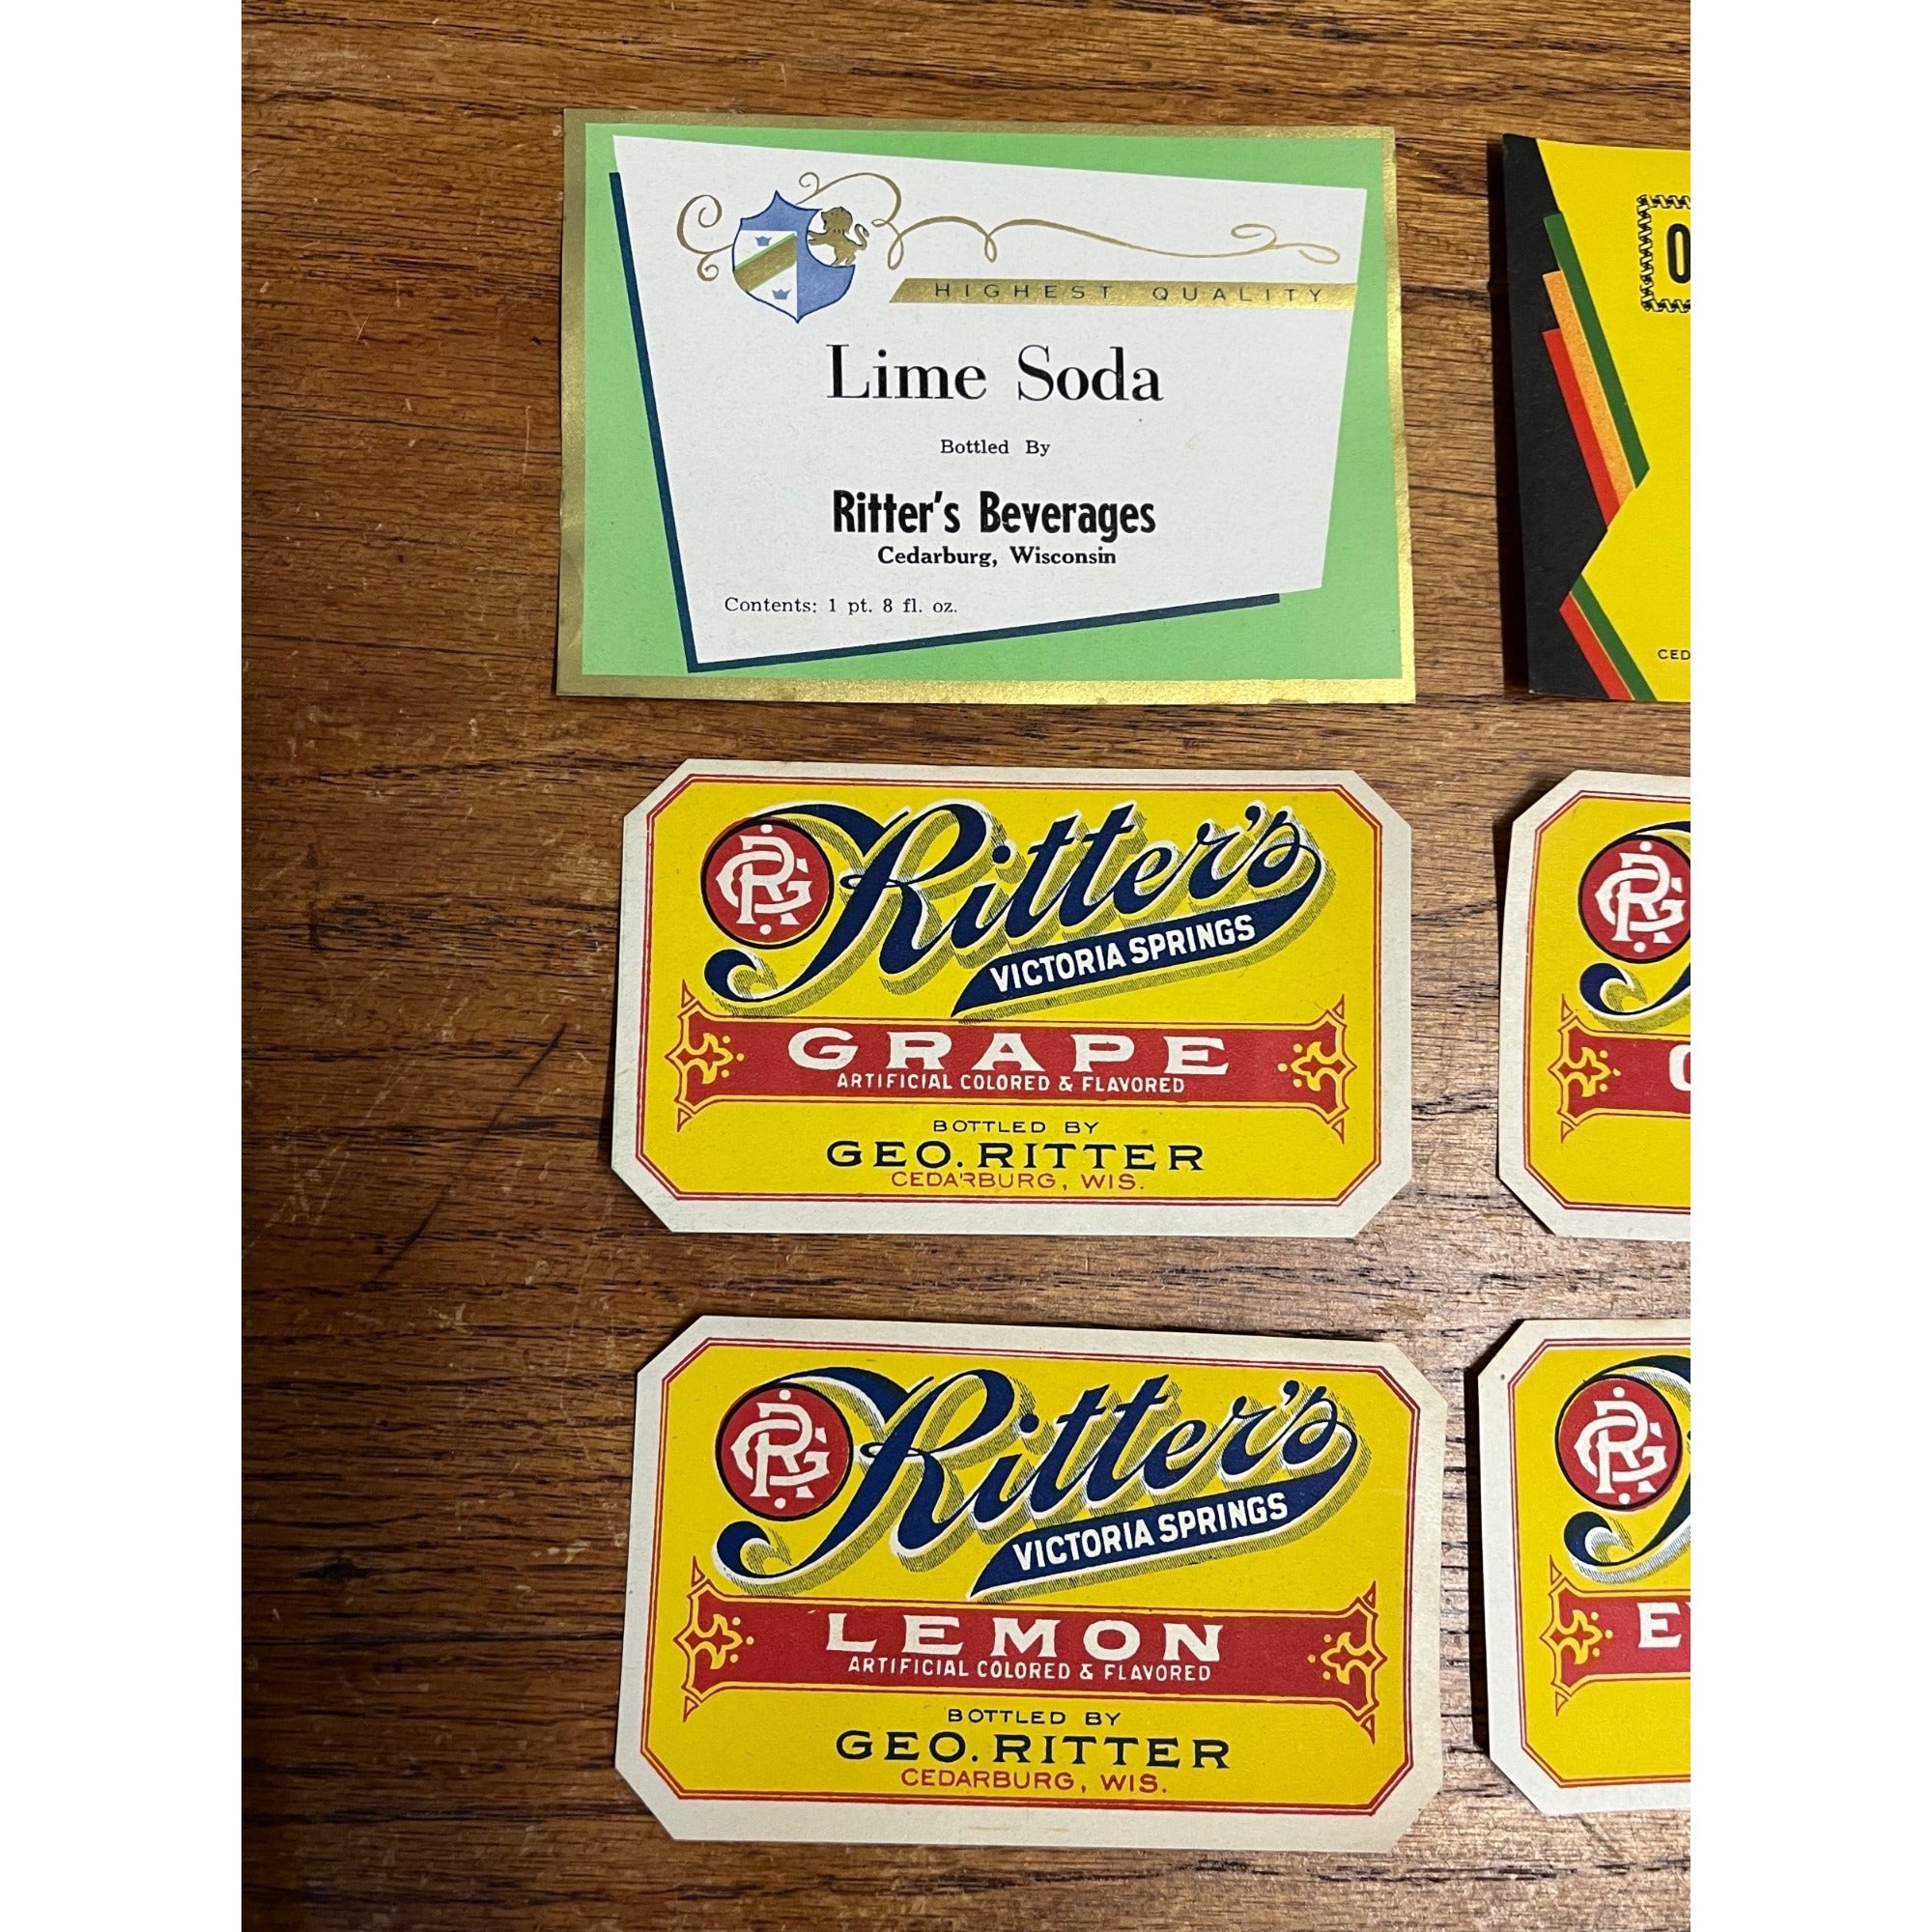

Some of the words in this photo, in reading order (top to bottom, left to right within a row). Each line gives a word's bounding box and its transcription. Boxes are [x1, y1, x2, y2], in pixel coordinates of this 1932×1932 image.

[935, 282, 1113, 300] HIGHEST
[1152, 284, 1324, 303] QUALITY
[826, 344, 987, 401] Lime
[1017, 345, 1164, 402] Soda
[940, 440, 1009, 455] Bottled
[1026, 440, 1051, 459] By
[833, 491, 961, 533] Ritter's
[980, 492, 1156, 543] Beverages
[878, 547, 998, 568] Cedarburg,
[1010, 547, 1117, 565] Wisconsin
[724, 597, 817, 613] Contents:
[829, 597, 837, 612] 1
[848, 599, 872, 617] pt.
[883, 597, 893, 613] 8
[903, 597, 923, 613] fl.
[932, 602, 957, 614] oz.
[705, 804, 1322, 1004] Ritter's
[990, 941, 1122, 994] VICTORIA
[1130, 914, 1256, 964] SPRINGS
[788, 1028, 1229, 1075] GRAPE
[837, 1073, 952, 1090] ARTIFICIAL
[960, 1074, 1049, 1092] COLORED
[1059, 1075, 1075, 1092] &
[1083, 1076, 1185, 1094] FLAVORED
[933, 1120, 1047, 1134] BOTTLED
[1065, 1122, 1099, 1135] BY
[1083, 1175, 1145, 1191] WIS.
[717, 1367, 1358, 1577] Ritter's
[1013, 1519, 1151, 1572] VICTORIA
[1158, 1492, 1289, 1542] SPRINGS
[827, 1613, 1223, 1662] LEMON
[1636, 1602, 1690, 1649] E
[848, 1657, 969, 1677] ARTIFICIAL
[977, 1661, 1069, 1679] COLORED
[1079, 1662, 1094, 1680] &
[1104, 1662, 1211, 1682] FLAVORED
[948, 1708, 1066, 1724] BOTTLED
[1085, 1711, 1121, 1726] BY
[900, 1769, 1089, 1795] CEDARBURG,
[1100, 1774, 1167, 1794] WIS.
